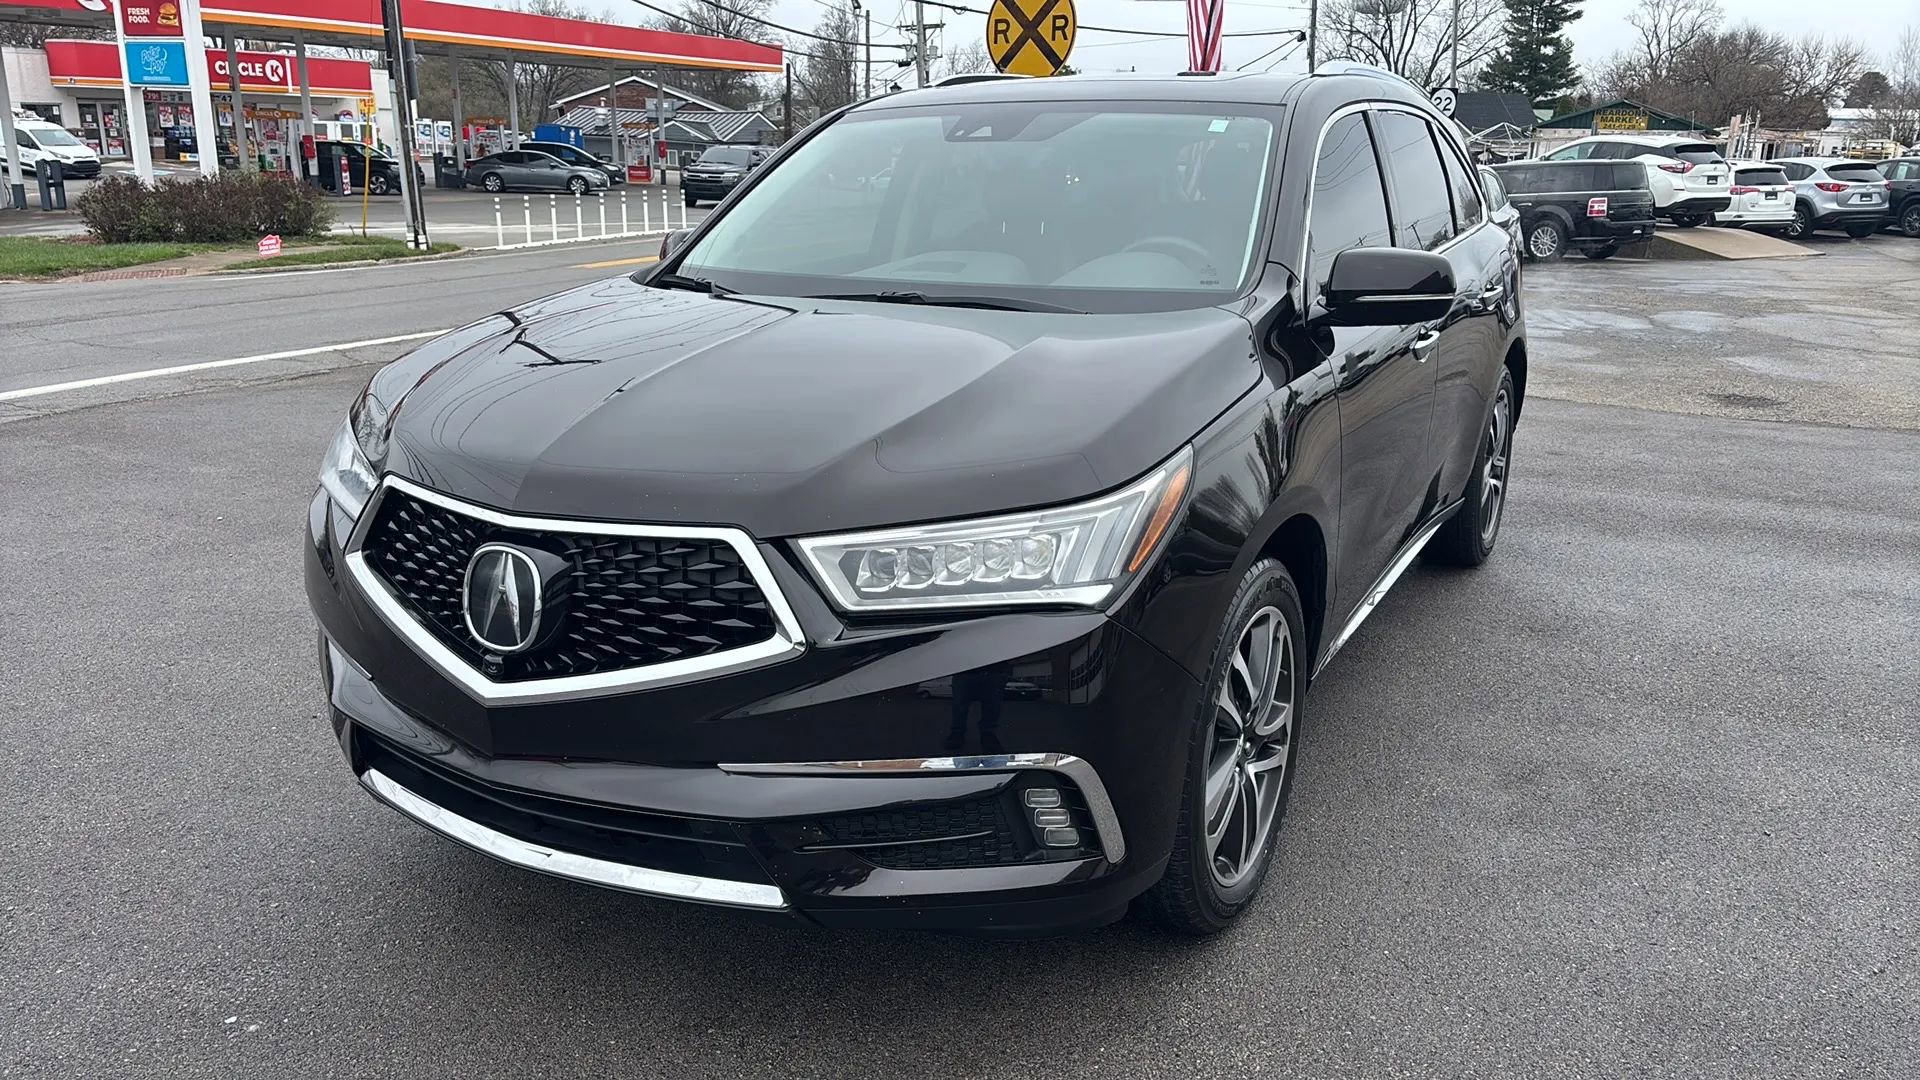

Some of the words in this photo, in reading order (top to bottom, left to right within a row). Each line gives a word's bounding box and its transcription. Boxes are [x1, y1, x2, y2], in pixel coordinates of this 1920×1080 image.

[994, 18, 1011, 44] R
[1051, 14, 1069, 41] R
[214, 60, 264, 76] CICLE
[268, 62, 283, 81] K
[1434, 96, 1452, 111] 22
